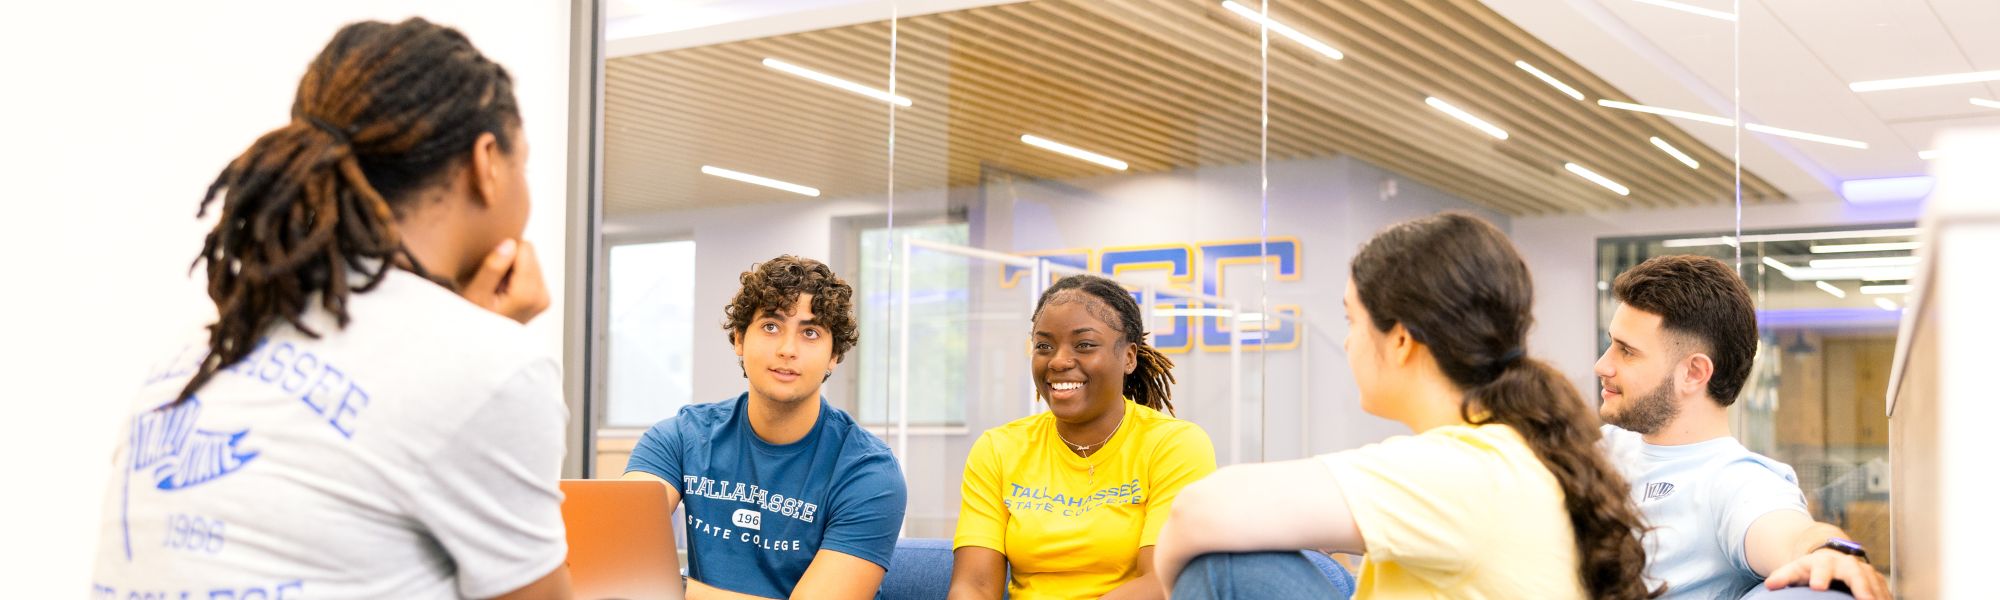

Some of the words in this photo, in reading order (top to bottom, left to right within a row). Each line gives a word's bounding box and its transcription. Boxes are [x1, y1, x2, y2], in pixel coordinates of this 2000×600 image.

[1003, 498, 1054, 513] STATE
[737, 512, 760, 526] 196
[688, 514, 732, 540] STATE
[740, 532, 800, 551] COLEGE
